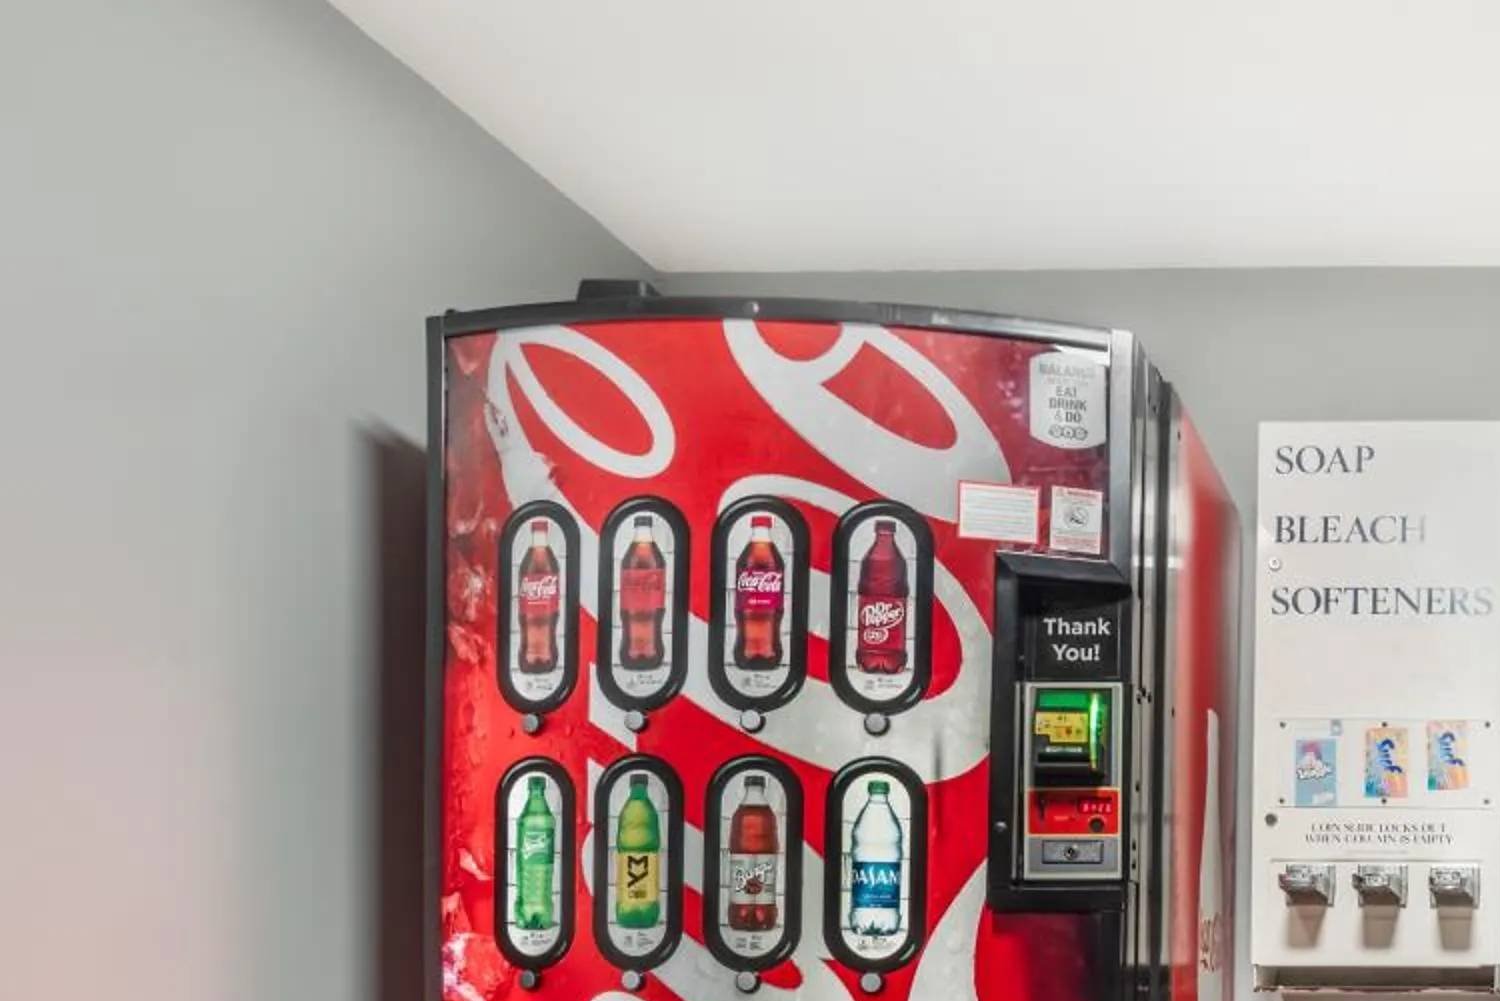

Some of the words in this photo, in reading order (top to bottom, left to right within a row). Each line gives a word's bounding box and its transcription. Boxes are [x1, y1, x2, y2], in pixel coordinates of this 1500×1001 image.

[1048, 397, 1087, 411] DRINK
[1275, 446, 1375, 475] SOAP
[1274, 515, 1427, 544] BLEACH
[1271, 586, 1494, 616] SOFTENERS
[1043, 617, 1111, 636] Thank
[1052, 643, 1101, 662] You!
